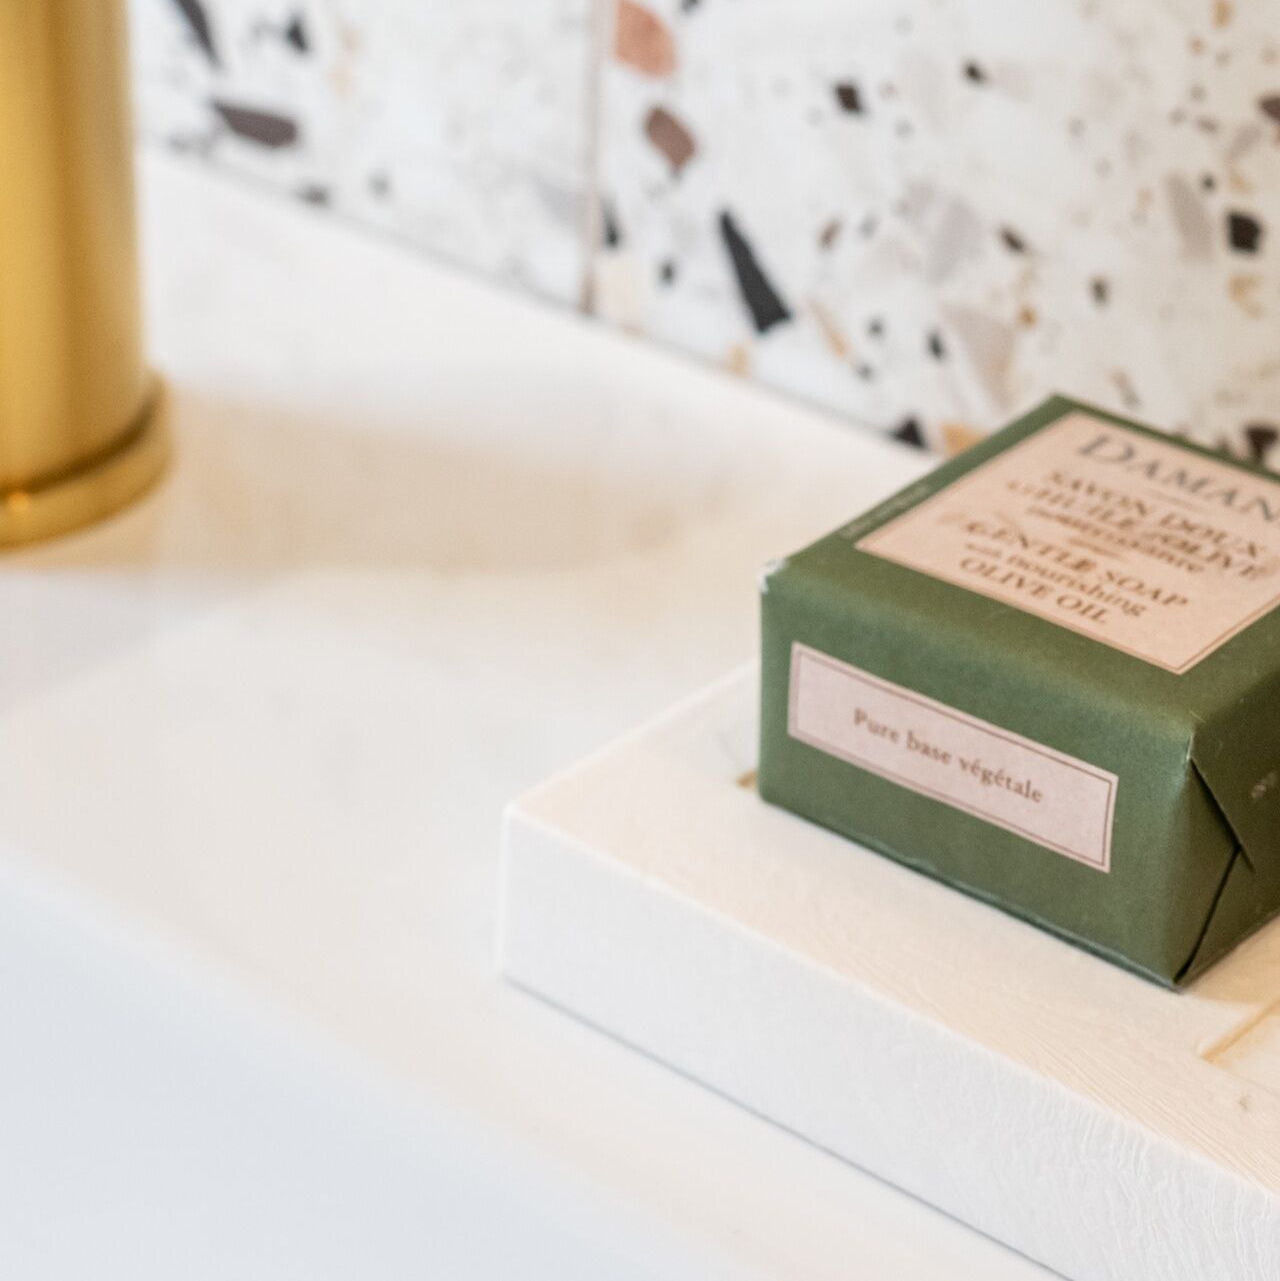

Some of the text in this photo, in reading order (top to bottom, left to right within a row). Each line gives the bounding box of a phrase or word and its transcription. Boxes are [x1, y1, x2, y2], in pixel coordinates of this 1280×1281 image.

[960, 556, 1109, 625] OLIVE OIL
[1103, 569, 1190, 609] SOAP
[853, 707, 1044, 803] Pure base végétale
